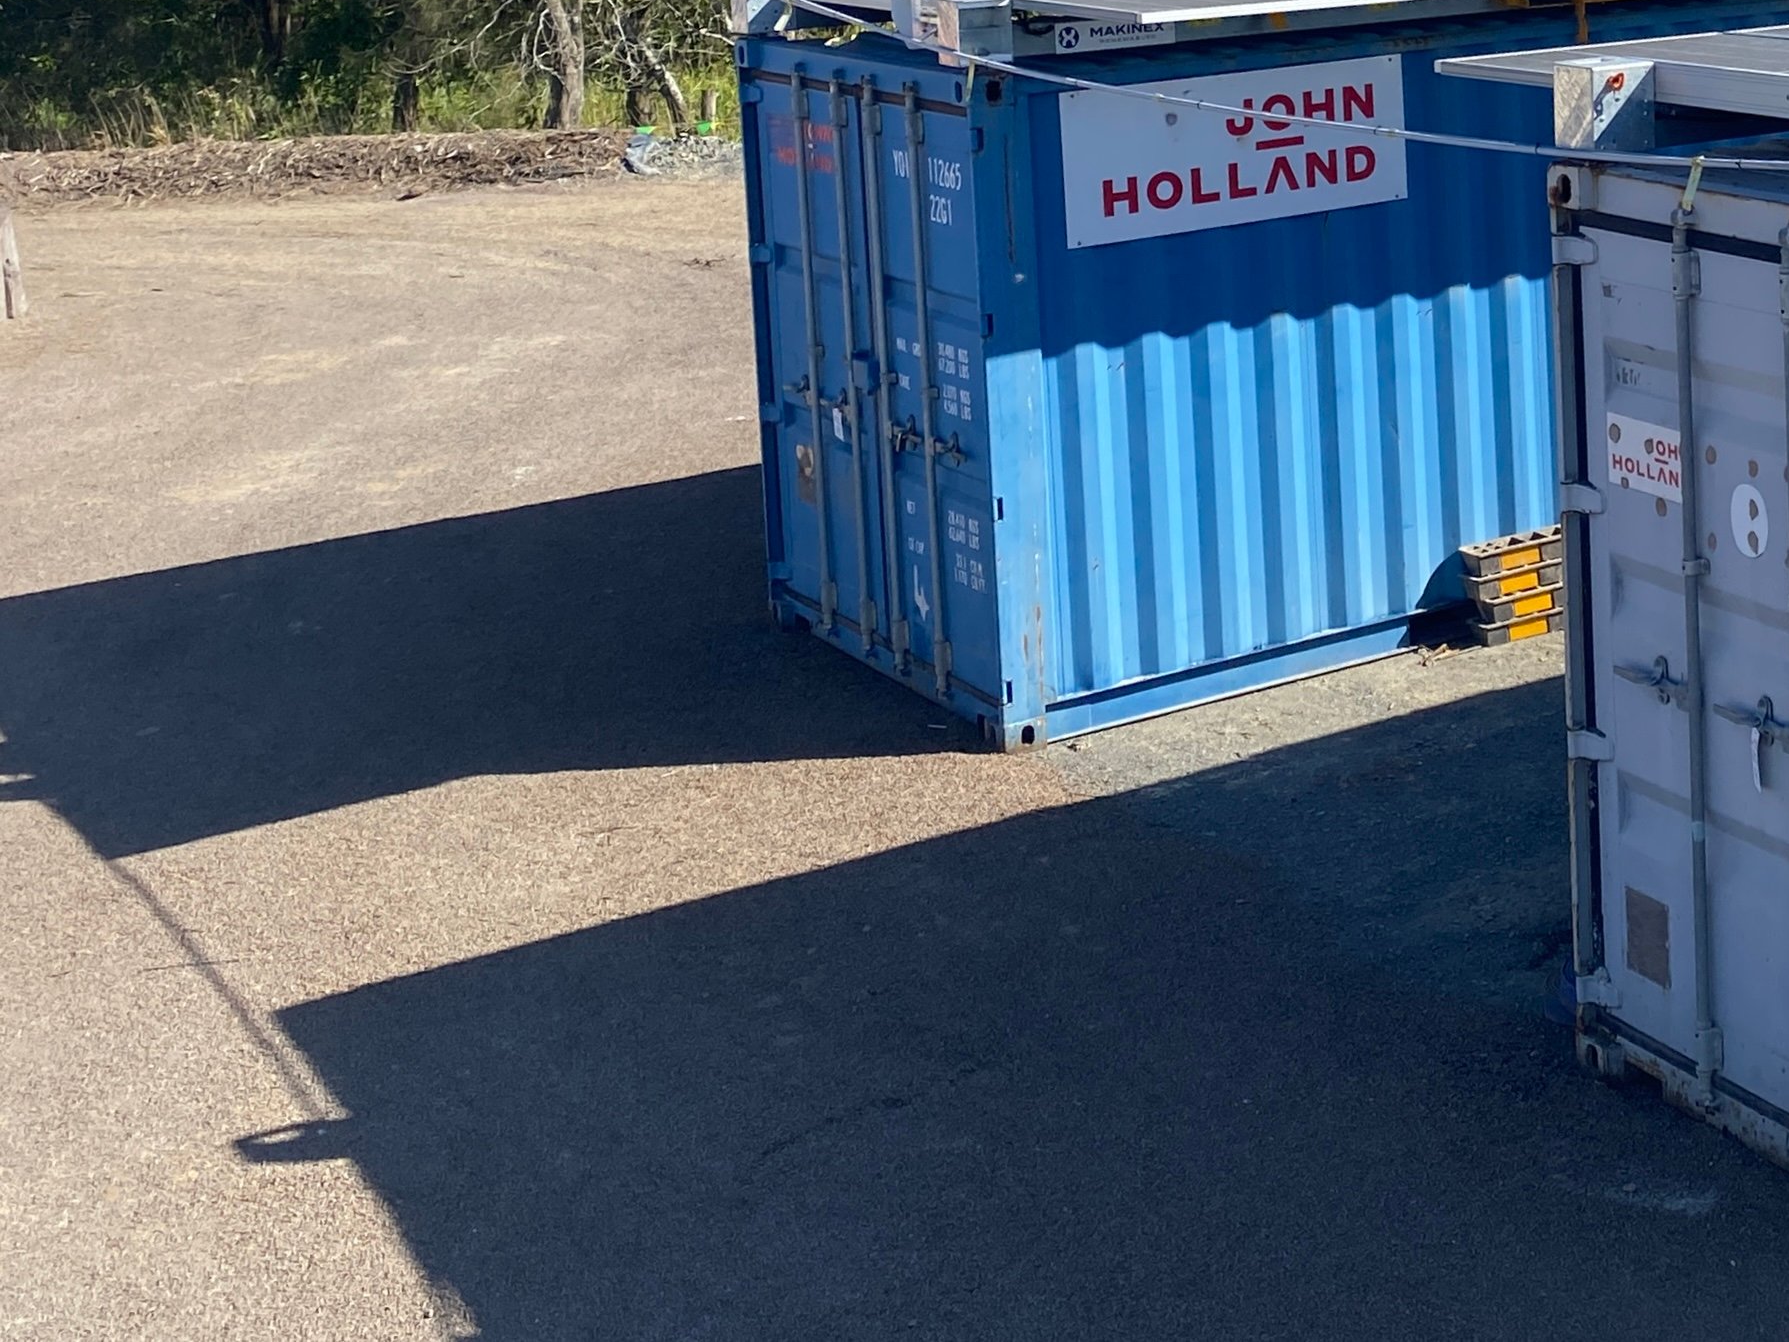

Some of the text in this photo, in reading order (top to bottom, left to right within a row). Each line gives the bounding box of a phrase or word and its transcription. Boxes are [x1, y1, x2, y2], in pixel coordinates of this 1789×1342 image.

[1089, 23, 1165, 37] MAKINEX
[1225, 83, 1375, 136] JOHN
[927, 157, 962, 190] 112665
[1102, 145, 1377, 217] HOLLAND
[929, 194, 953, 226] 22G1
[1611, 453, 1680, 488] HOLLAN
